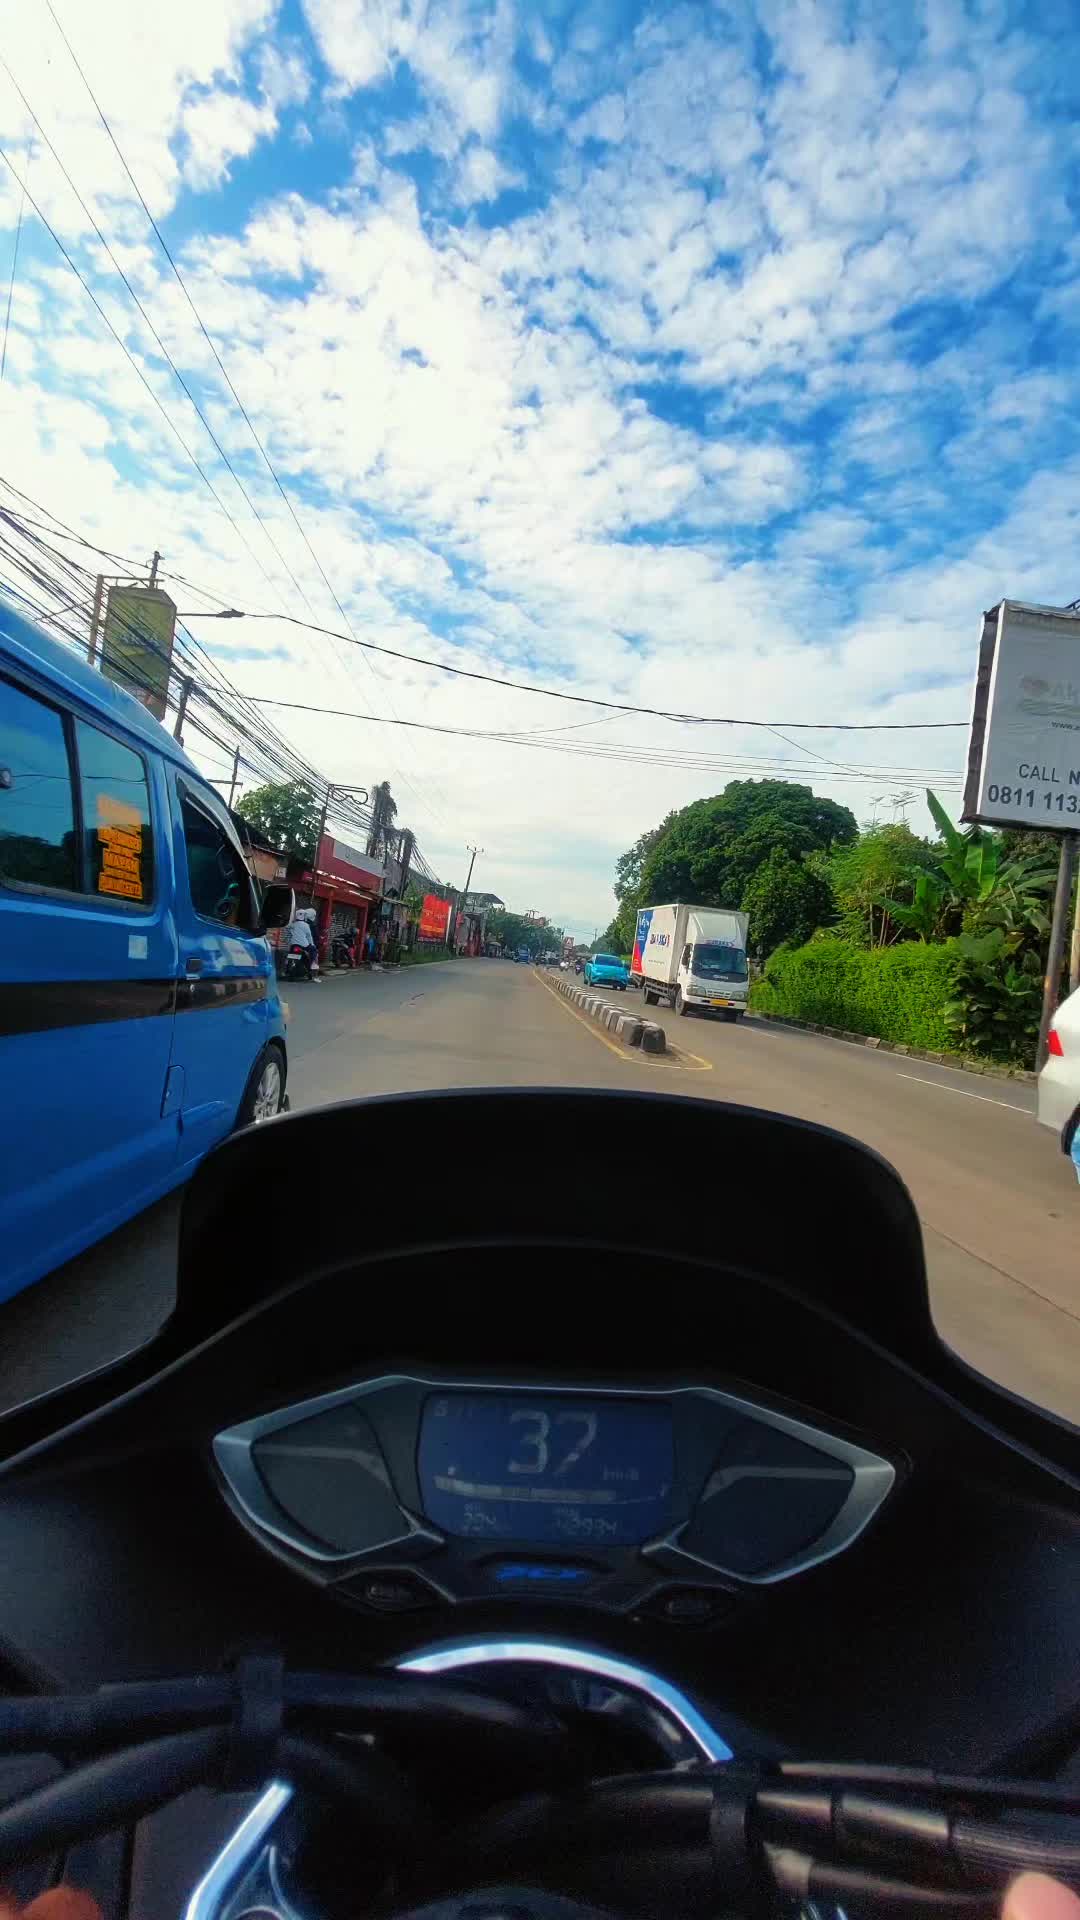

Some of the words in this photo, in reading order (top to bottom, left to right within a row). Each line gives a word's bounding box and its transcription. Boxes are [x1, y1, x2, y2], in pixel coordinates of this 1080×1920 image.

[1018, 764, 1060, 782] CALL
[988, 785, 1035, 807] 0811
[1043, 791, 1080, 813] 113
[507, 1409, 597, 1475] 37
